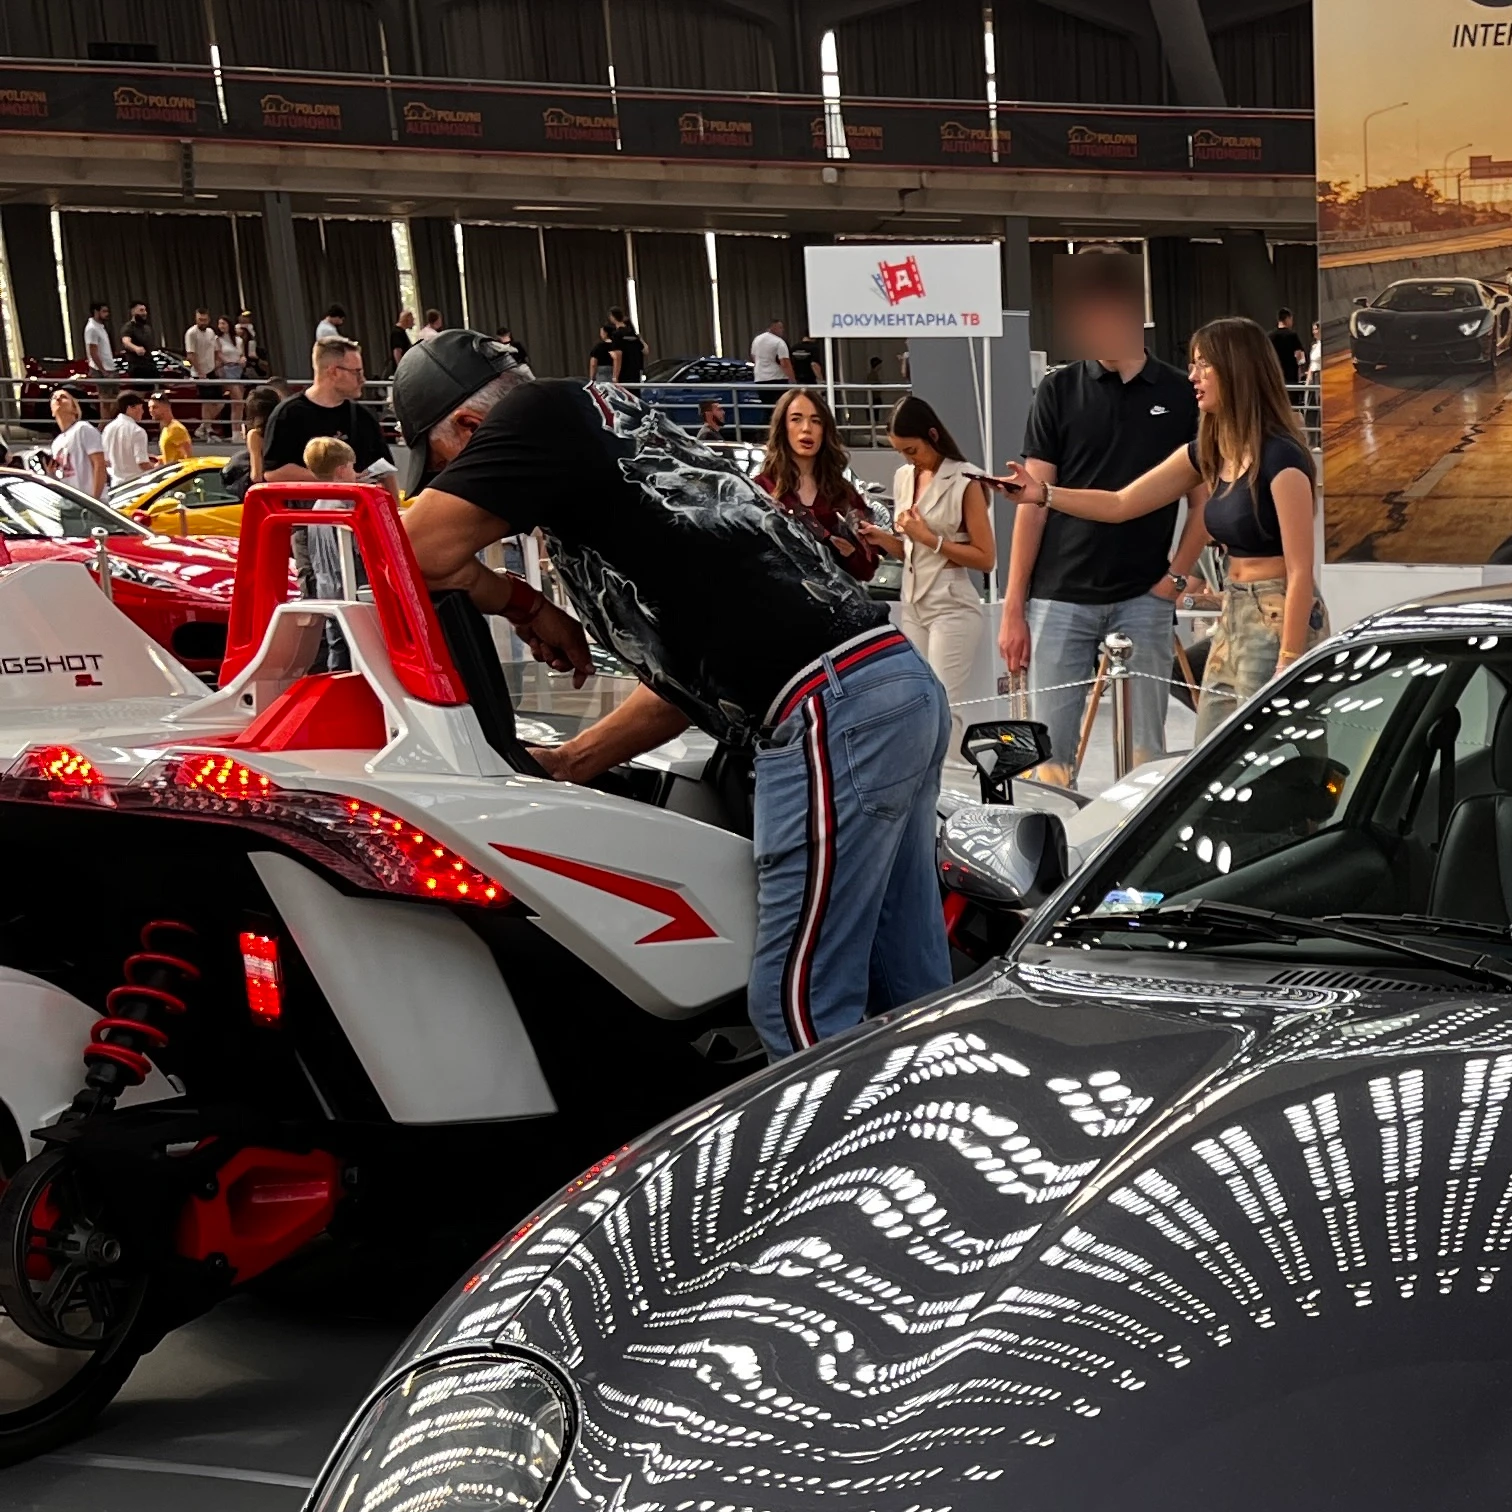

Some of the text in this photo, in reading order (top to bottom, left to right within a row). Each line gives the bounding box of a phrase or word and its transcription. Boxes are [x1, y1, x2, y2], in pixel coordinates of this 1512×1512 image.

[148, 95, 195, 108] POLOVNI
[116, 107, 197, 123] AUTOMOBILI
[295, 103, 340, 116] POLOVNI
[263, 114, 342, 130] AUTOMOBILI
[437, 111, 481, 123] POLOVNI
[406, 121, 483, 137] AUTOMOBILI
[709, 120, 751, 132] POLOVNI
[1097, 134, 1137, 144] POLOVNI
[1221, 136, 1262, 148] POLOVNI
[1068, 144, 1137, 158] AUTOMOBILI
[1193, 147, 1262, 161] AUTOMOBILI
[831, 313, 980, 329] ДОКУМЕНТАРНА ТВ
[0, 654, 103, 674] GSHOT
